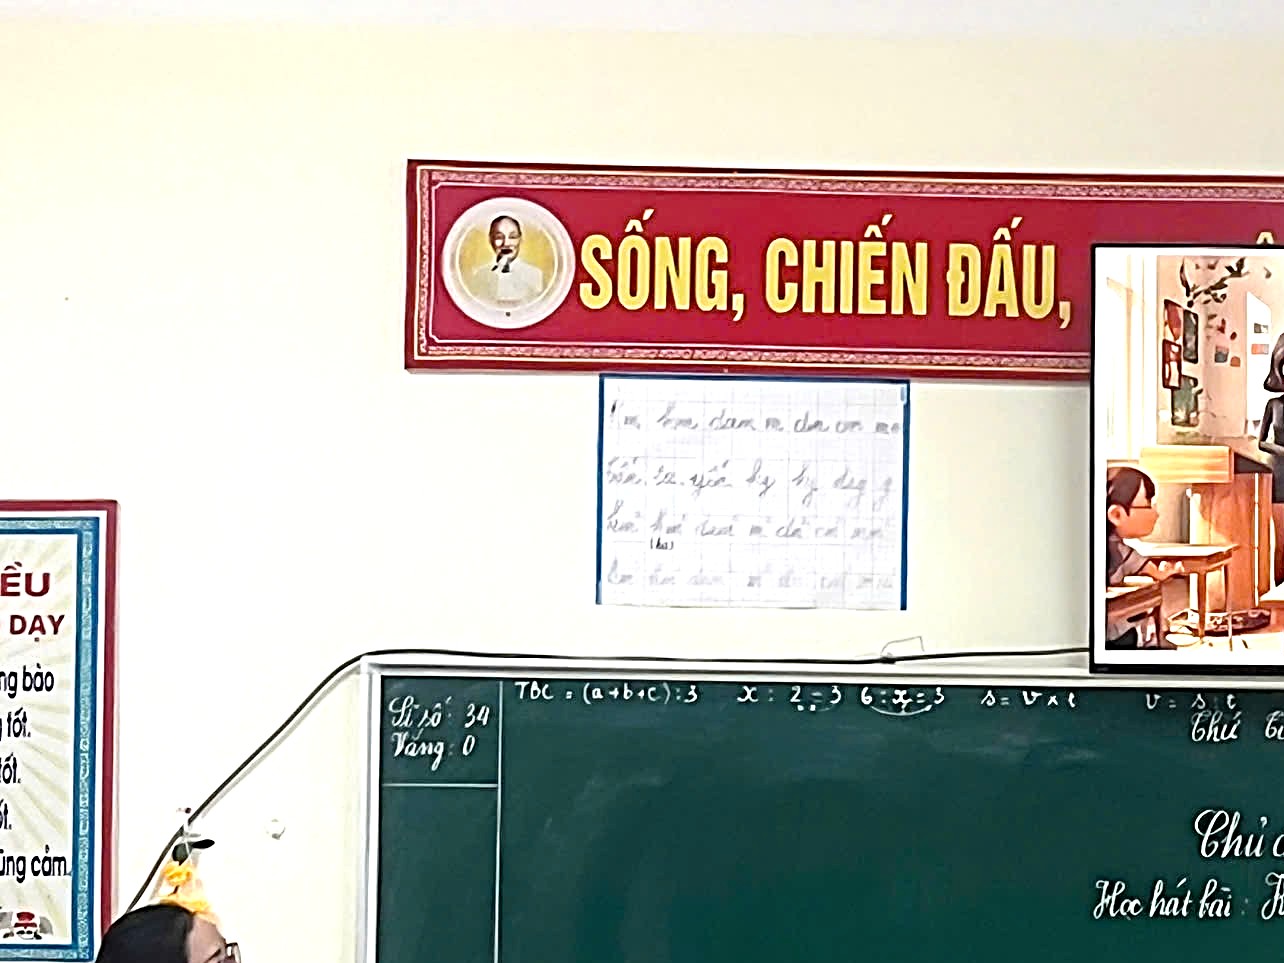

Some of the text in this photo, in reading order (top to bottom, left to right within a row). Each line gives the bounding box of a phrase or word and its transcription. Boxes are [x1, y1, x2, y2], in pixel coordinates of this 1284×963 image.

[580, 208, 1073, 330] SỐNG, CHIẾN ĐẤU,
[0, 561, 51, 597] ỀU
[9, 614, 65, 642] DẠY
[0, 662, 55, 699] ng bào
[515, 681, 554, 701] TBC
[464, 703, 490, 728] 34
[462, 734, 476, 756] 0
[1194, 808, 1269, 859] Chủ
[1093, 879, 1144, 921] Học
[1149, 877, 1193, 918] hát
